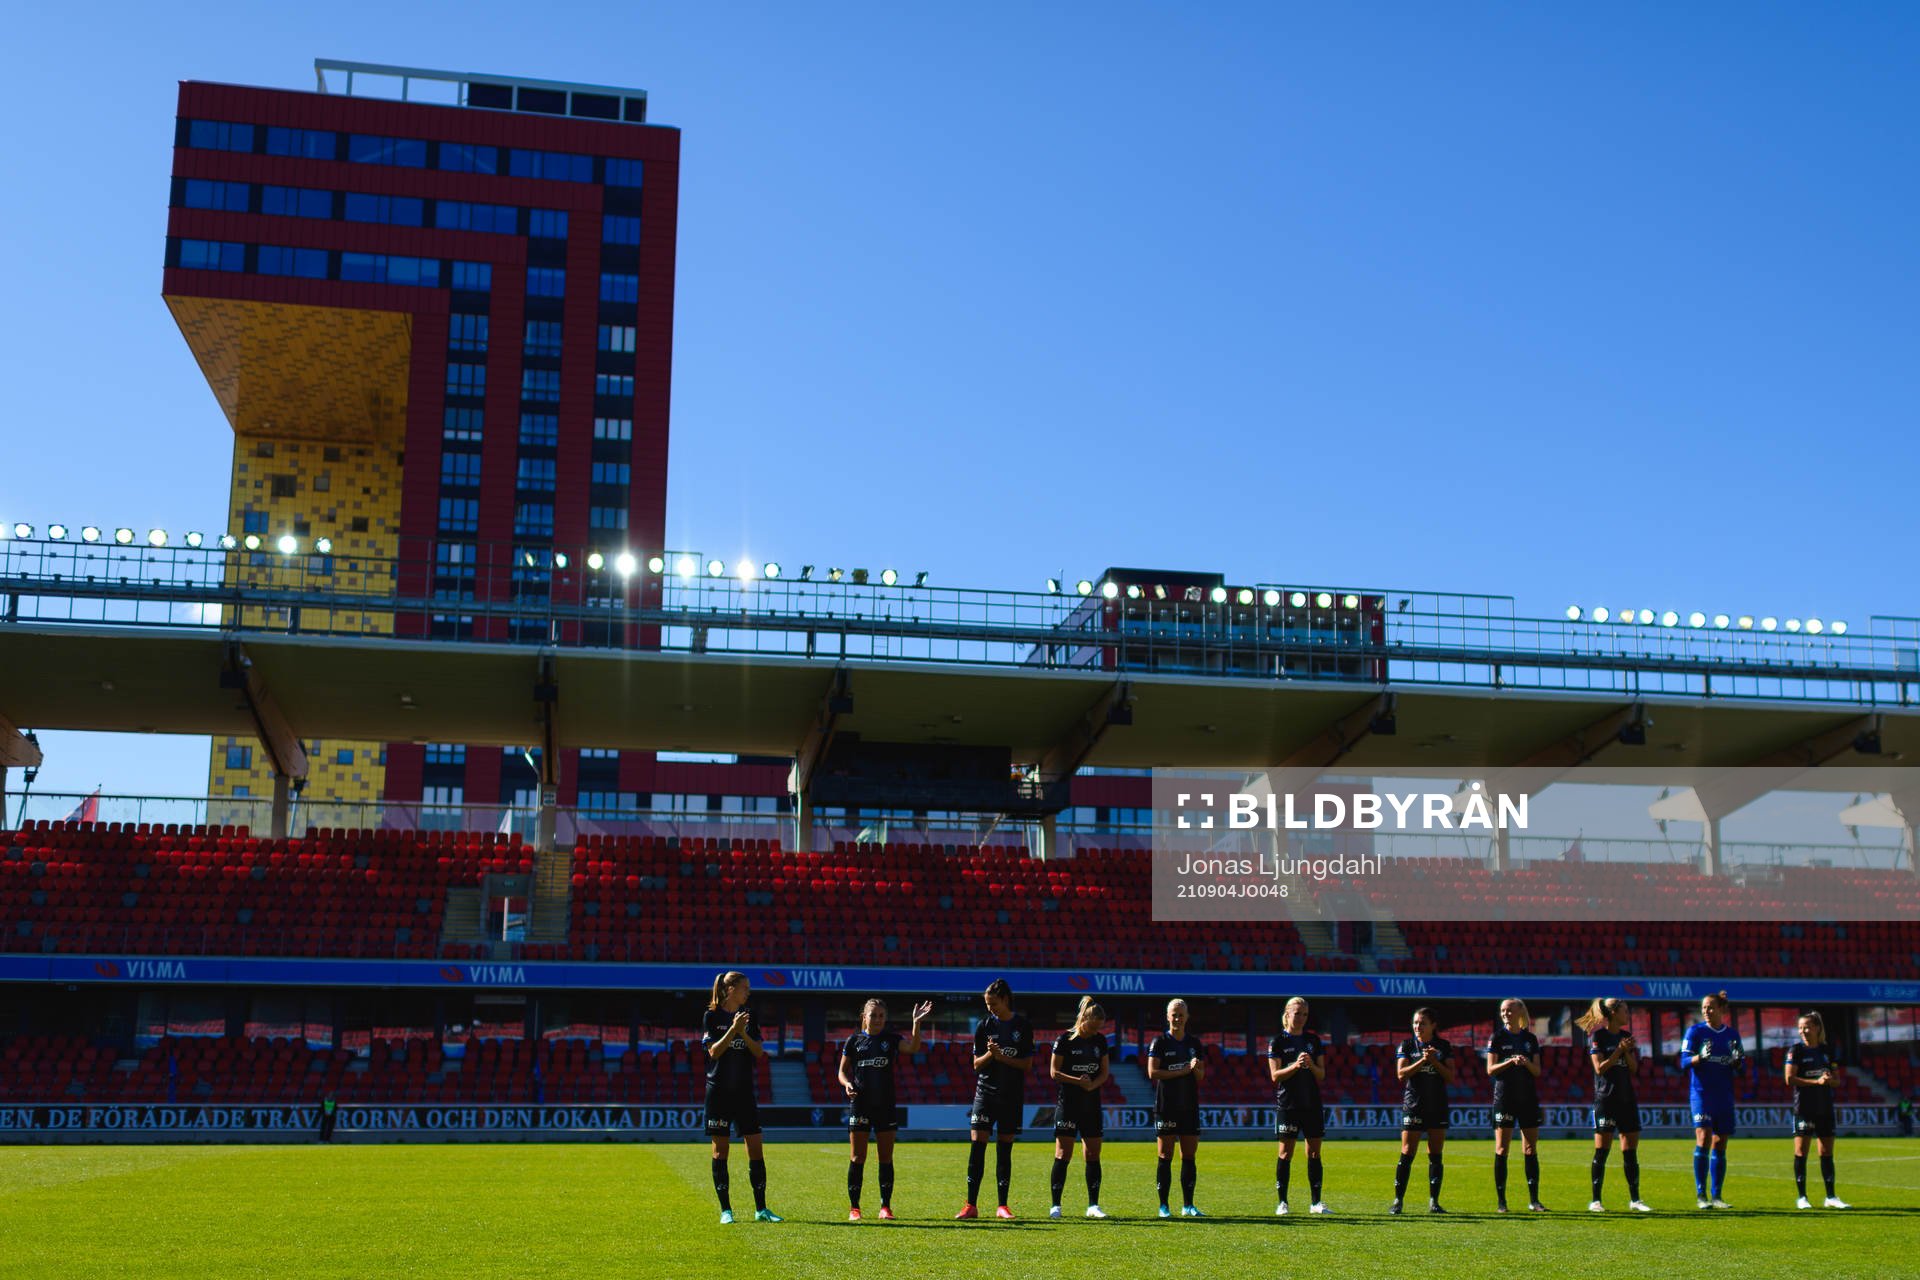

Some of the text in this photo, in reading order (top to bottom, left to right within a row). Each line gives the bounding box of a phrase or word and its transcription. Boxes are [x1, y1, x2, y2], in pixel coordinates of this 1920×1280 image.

[127, 961, 186, 978] VISMA
[469, 966, 526, 983] VISMA
[792, 970, 845, 988] VISMA
[1093, 975, 1145, 992] VISMA
[1379, 978, 1428, 995] VISMA
[1647, 982, 1694, 998] VISMA
[47, 1109, 83, 1129] DE
[87, 1105, 246, 1129] FÖRÄDLADE
[426, 1109, 478, 1129] OCH
[483, 1109, 533, 1129] DEN
[538, 1109, 634, 1129] LOKALA
[1101, 1109, 1149, 1128] MED
